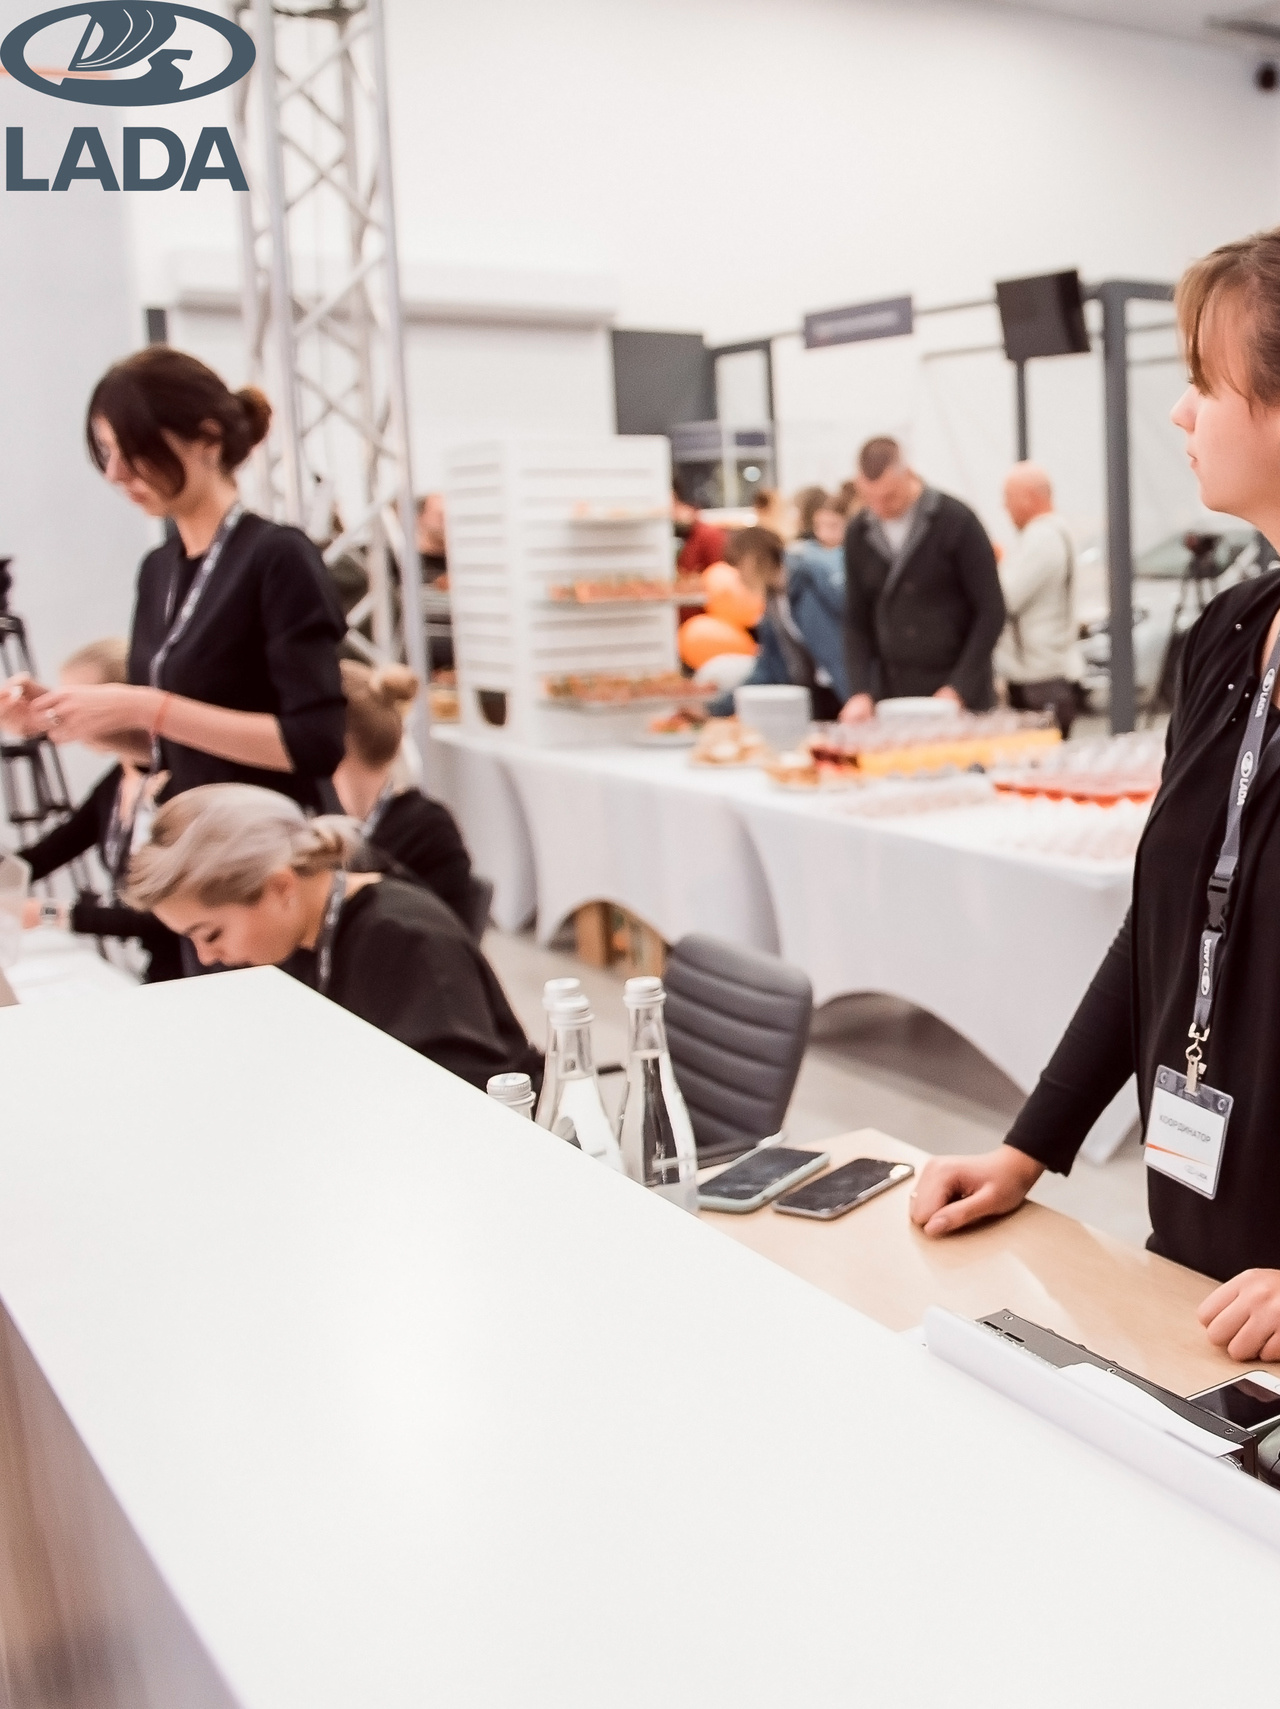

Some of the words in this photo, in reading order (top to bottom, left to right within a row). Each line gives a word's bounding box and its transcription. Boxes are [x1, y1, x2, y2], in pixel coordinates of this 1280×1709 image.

[1255, 692, 1268, 717] LADA
[1237, 778, 1249, 806] LADA
[1203, 939, 1212, 967] LADA
[1160, 1115, 1211, 1142] КООРДИНАТОР
